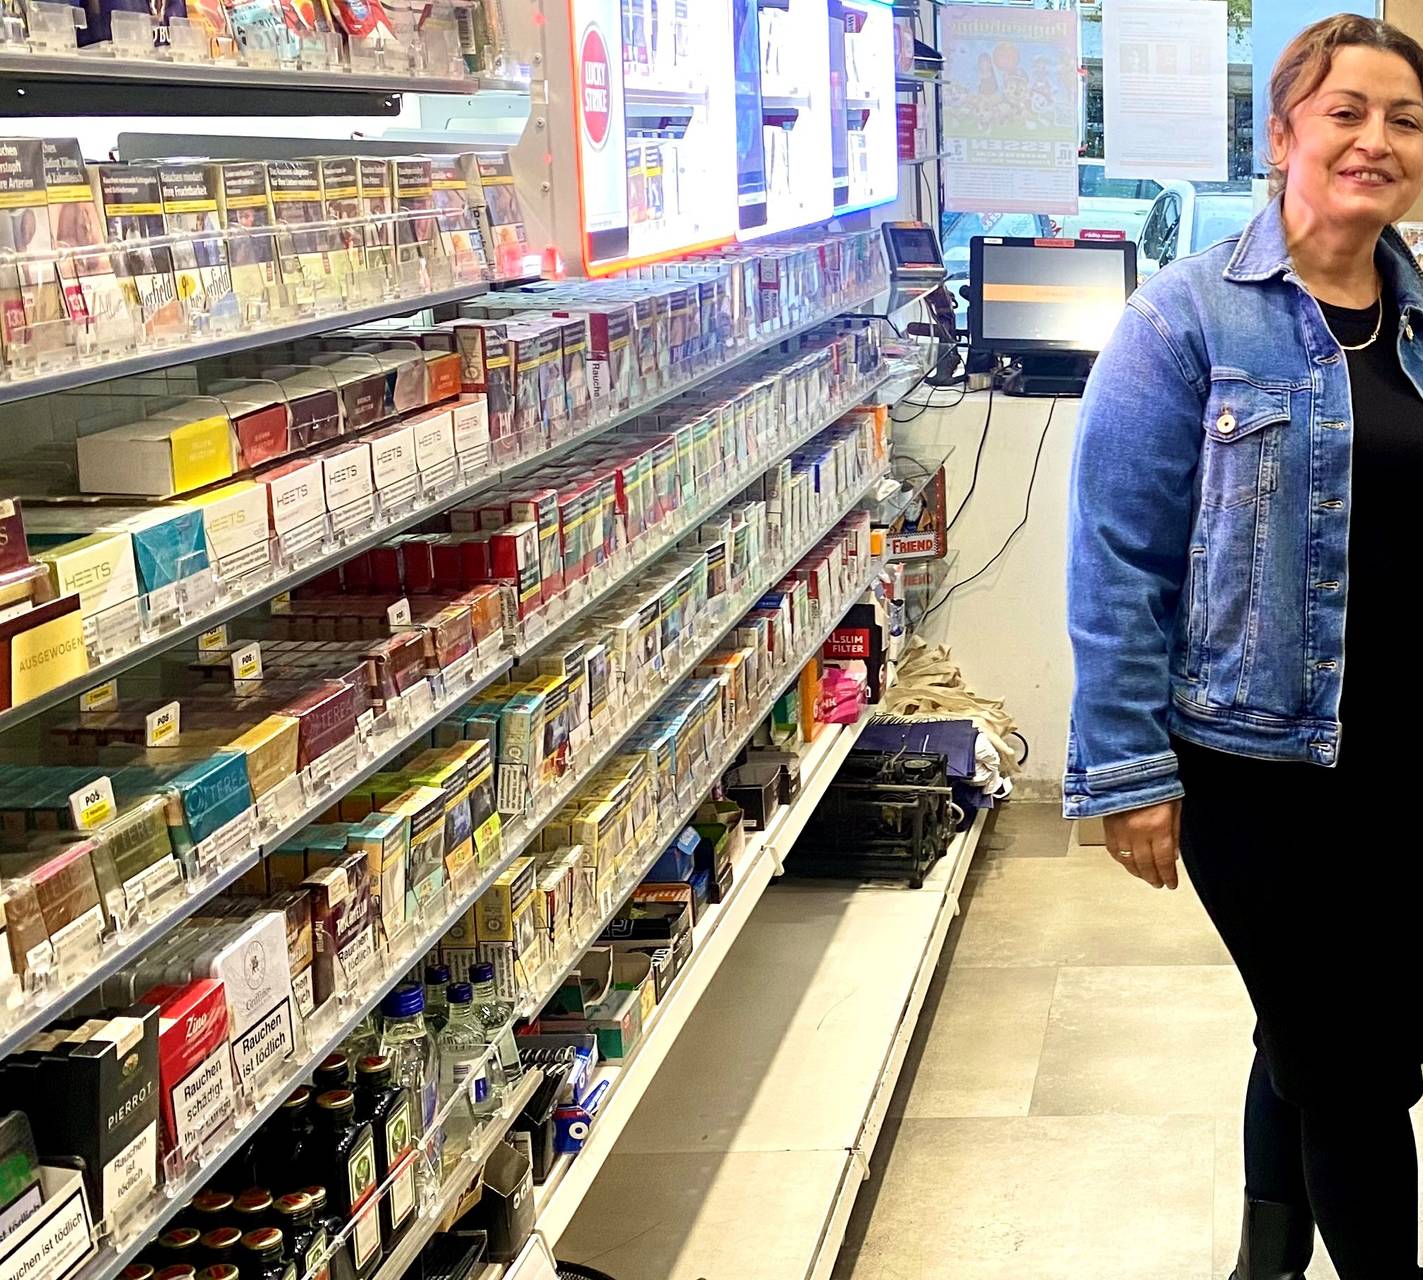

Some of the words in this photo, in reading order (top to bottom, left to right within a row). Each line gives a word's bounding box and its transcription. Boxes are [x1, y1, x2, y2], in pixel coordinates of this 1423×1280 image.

[592, 363, 601, 398] Rauche
[418, 431, 442, 446] HEETS
[376, 446, 403, 464] HEETS
[329, 464, 358, 483] HEETS
[276, 484, 309, 507] HEETS
[892, 538, 934, 553] FRIEND
[65, 562, 112, 590] HEETS
[832, 644, 864, 653] FILTER
[840, 635, 864, 643] SLIM
[18, 635, 84, 673] AUSGEWOGEN
[157, 713, 169, 727] POS
[84, 790, 100, 807] POS
[242, 1013, 282, 1055] Rauchen
[242, 1058, 255, 1078] ist
[255, 1032, 287, 1065] tödlich
[184, 1060, 222, 1101] Rauchen
[107, 1081, 153, 1130] PIERROT
[186, 1078, 224, 1122] schädigt
[114, 1136, 148, 1173] Rauchen
[126, 1159, 137, 1175] ist
[117, 1168, 144, 1198] tödlich
[8, 1252, 41, 1280] auchen
[41, 1239, 54, 1257] ist
[54, 1212, 83, 1244] tödlich
